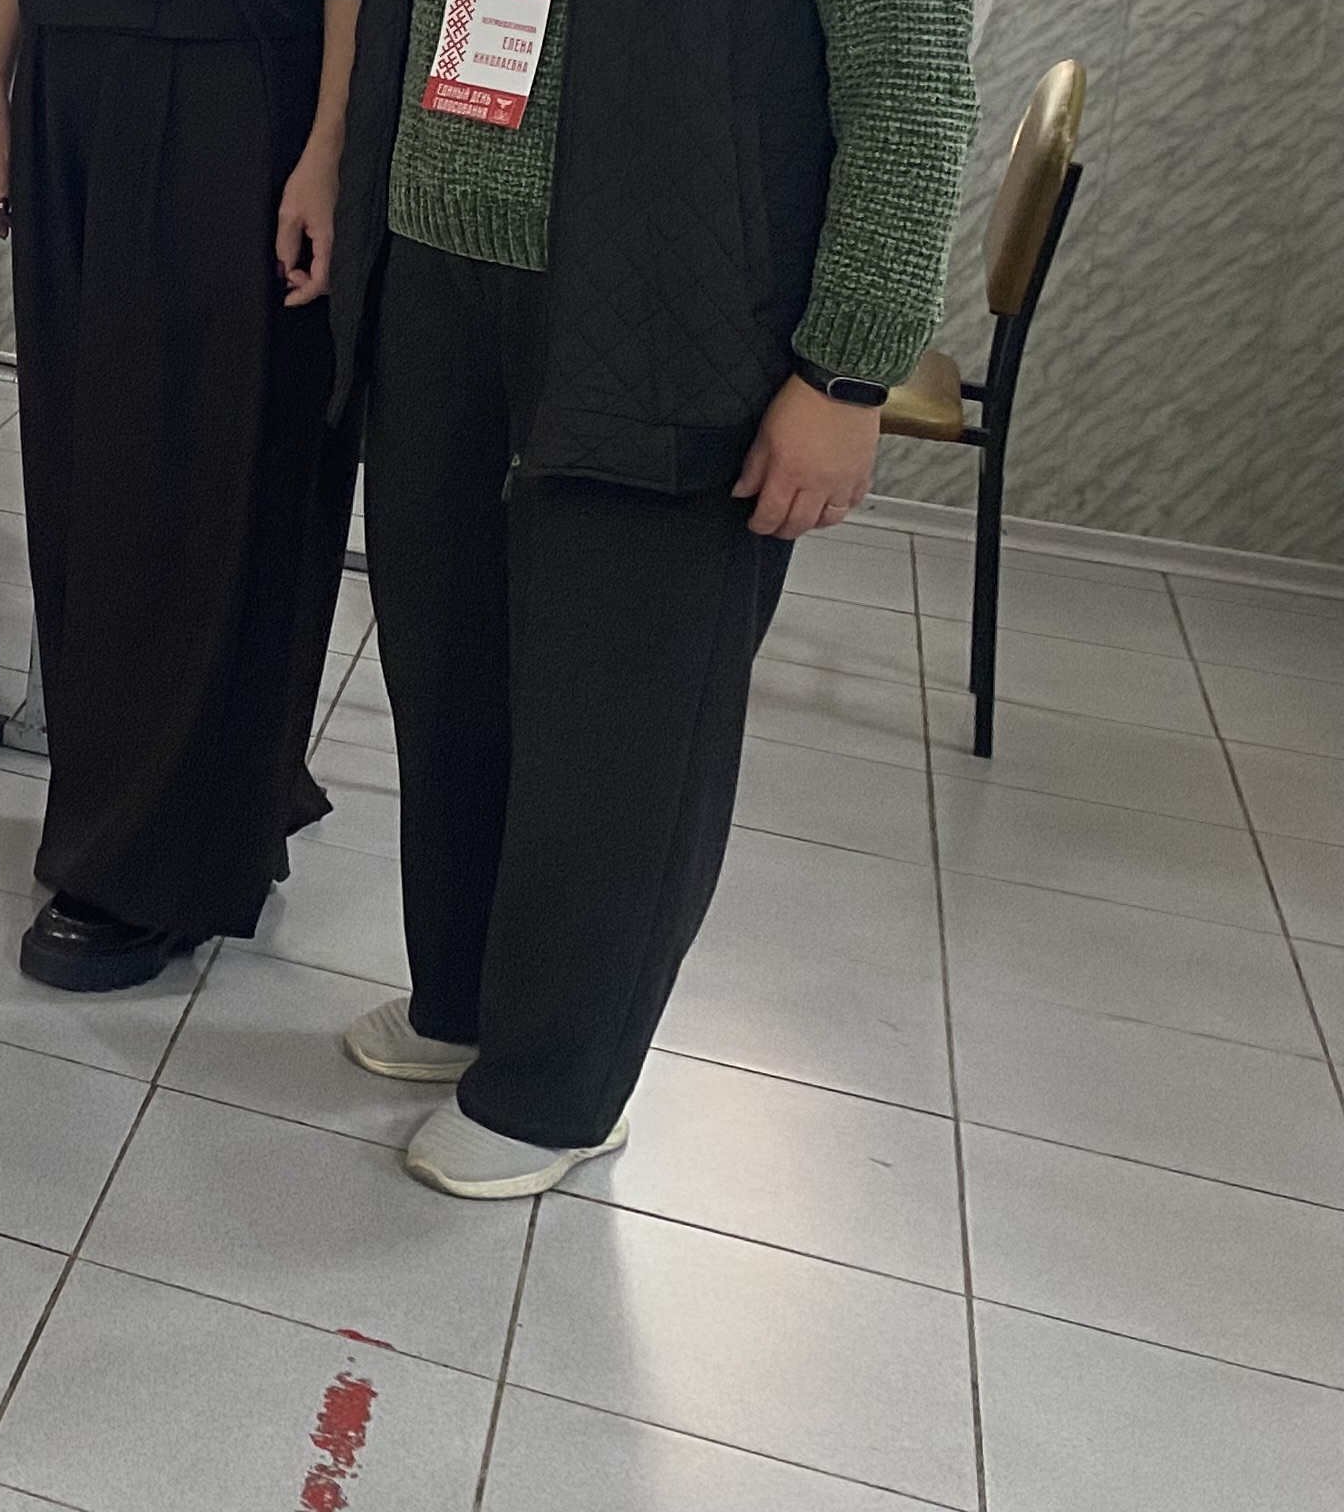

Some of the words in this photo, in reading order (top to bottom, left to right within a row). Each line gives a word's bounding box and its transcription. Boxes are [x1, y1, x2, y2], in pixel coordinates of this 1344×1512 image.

[501, 36, 534, 55] ЕЛЕНА
[472, 52, 529, 73] НИКОЛАЕВНА
[437, 83, 470, 101] ЕДИНЫЙ
[469, 90, 492, 106] ДЕНЬ
[433, 96, 489, 120] ГОЛОСОВАНИЯ
